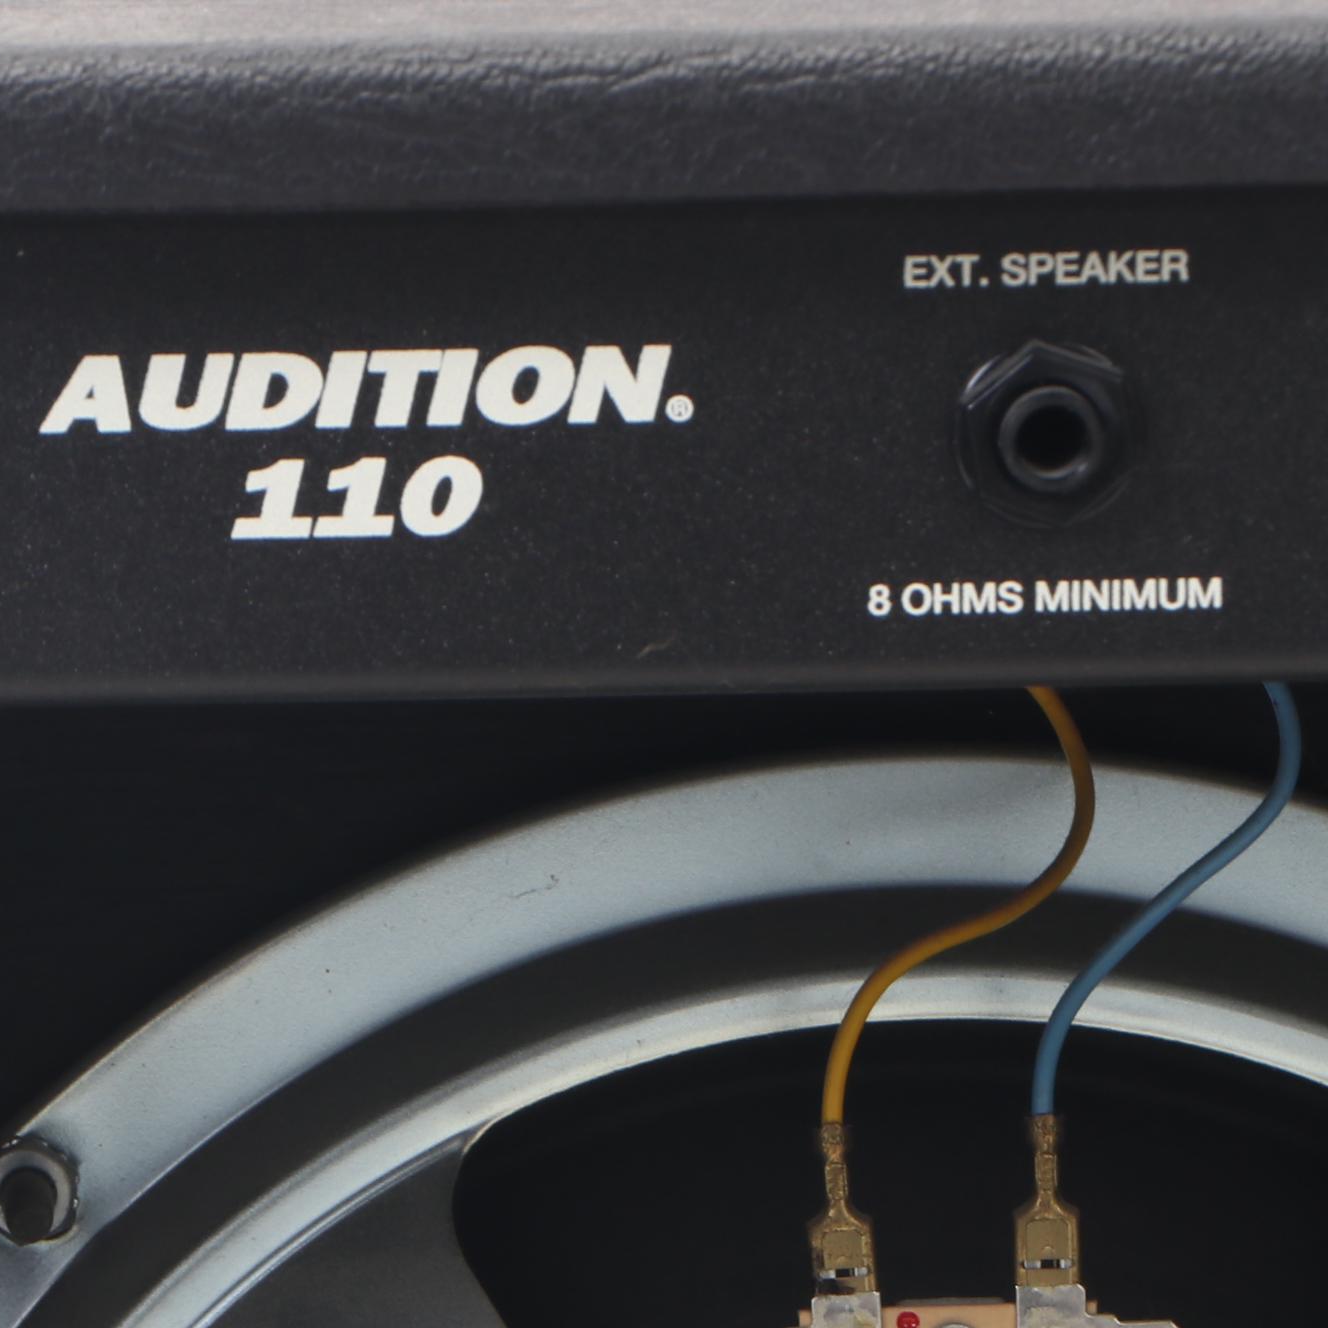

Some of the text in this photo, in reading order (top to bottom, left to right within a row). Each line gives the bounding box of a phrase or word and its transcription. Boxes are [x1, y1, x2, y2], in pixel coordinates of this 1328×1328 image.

[903, 249, 1189, 288] EXT. SPEAKER
[230, 455, 483, 540] 110
[867, 576, 1223, 616] 8 OHMS MINIMUM
